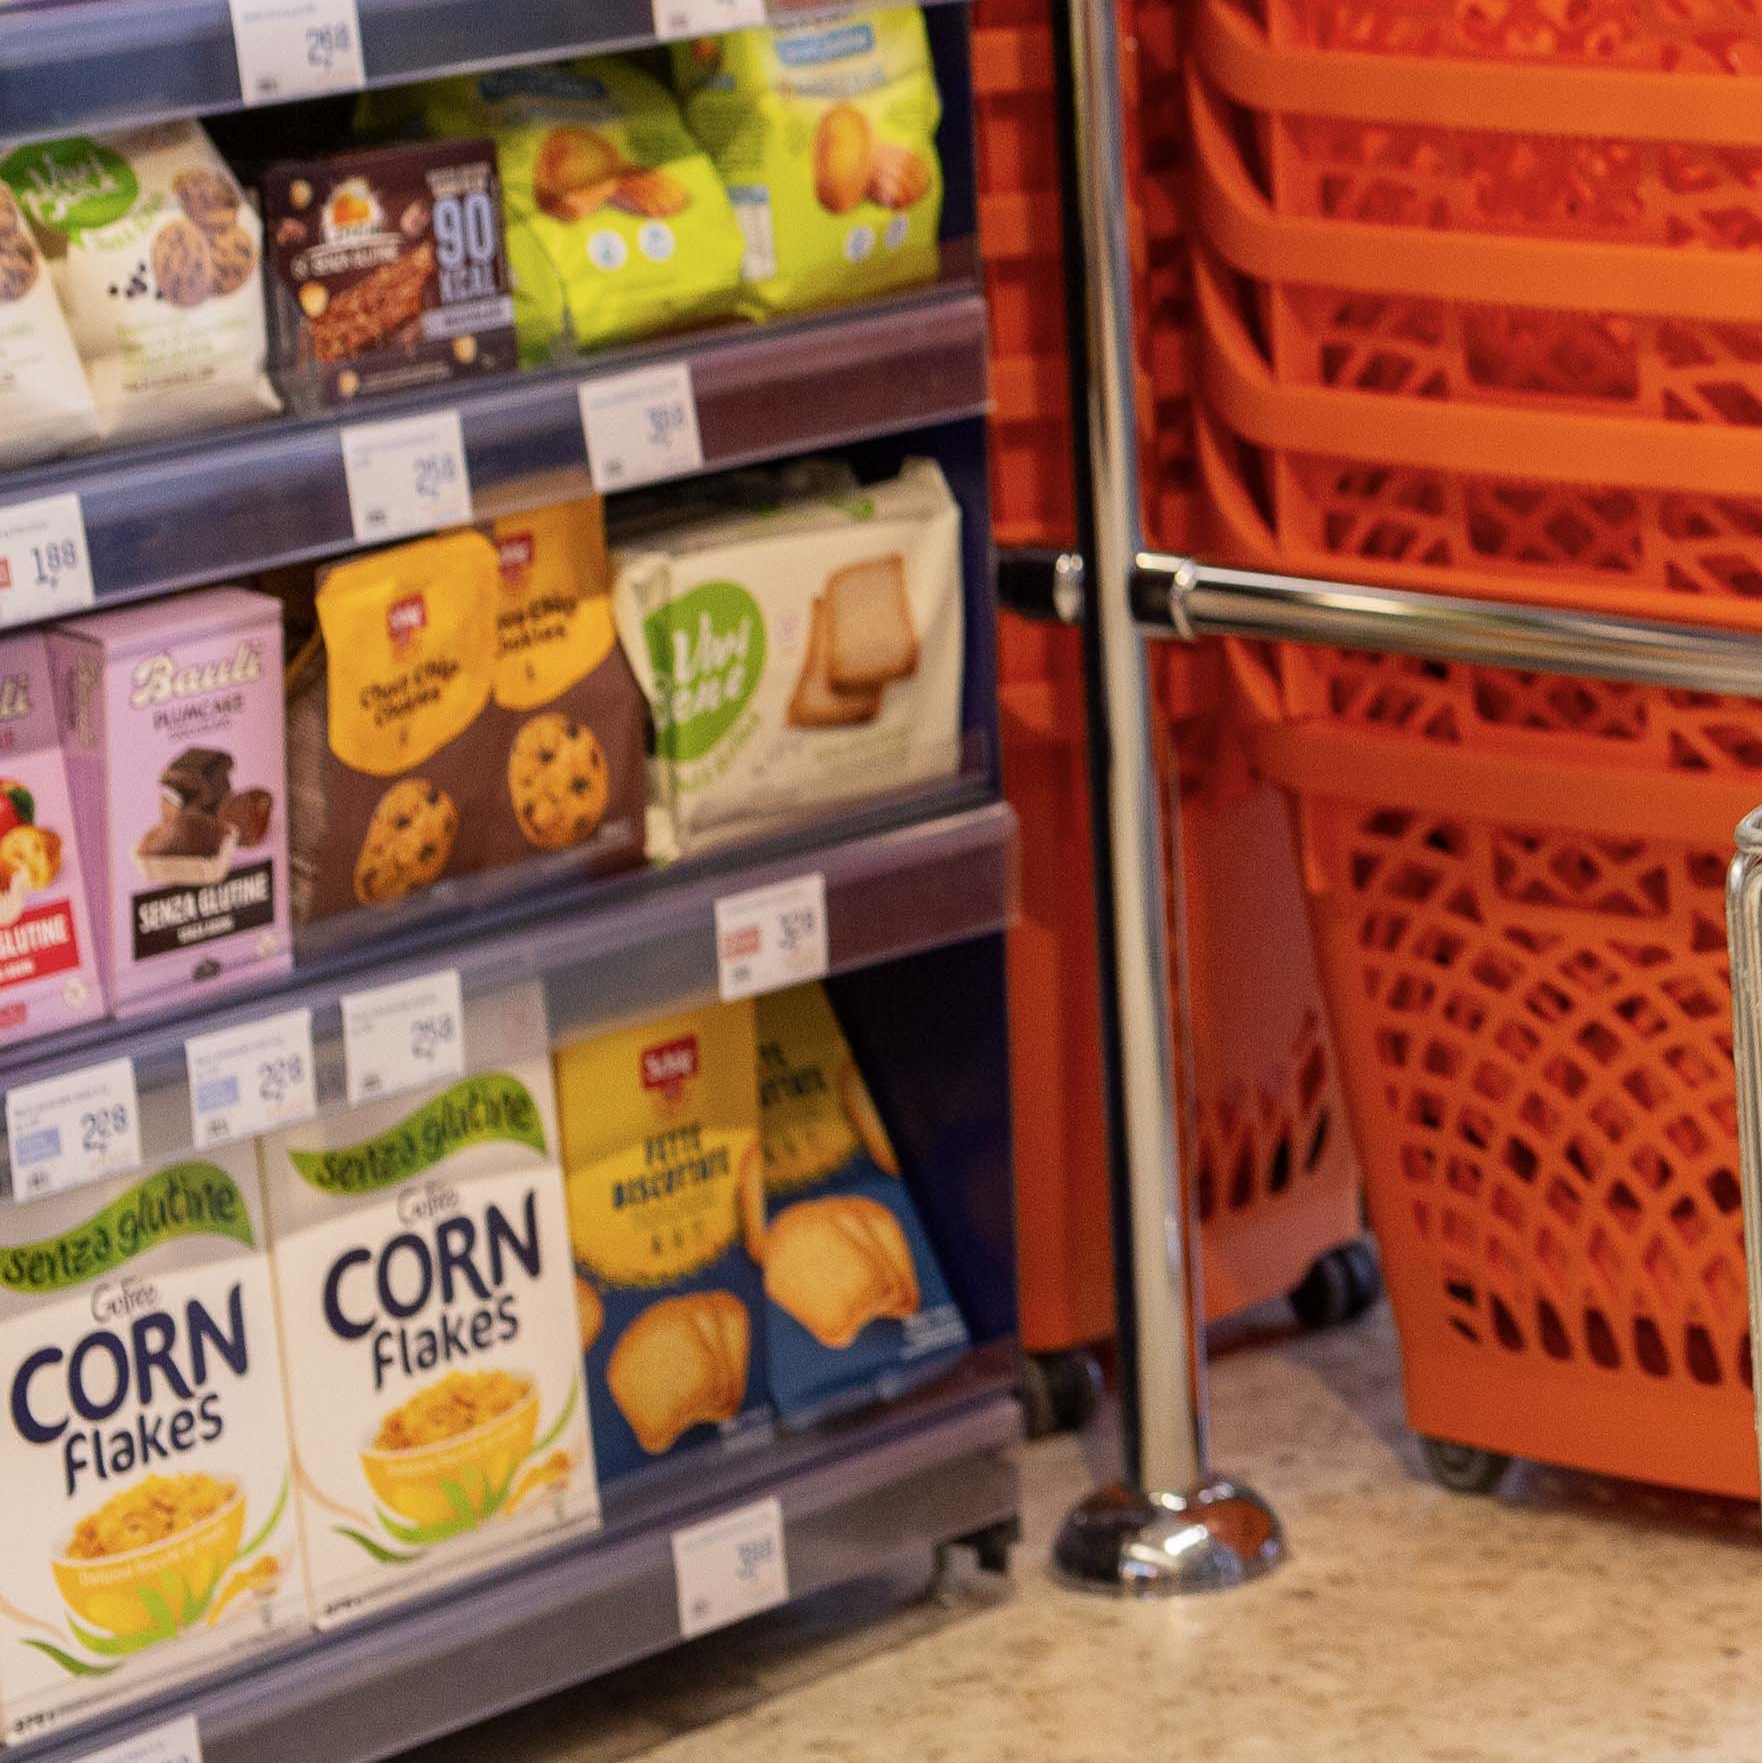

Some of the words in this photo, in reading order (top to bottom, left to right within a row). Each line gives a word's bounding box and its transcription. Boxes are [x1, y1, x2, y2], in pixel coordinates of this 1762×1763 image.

[431, 190, 497, 274] 90
[128, 640, 266, 711] Bauli
[138, 889, 195, 935] SENZA
[197, 871, 271, 918] GLUTINE
[313, 1135, 414, 1191] senza
[416, 1083, 536, 1166] glutine
[3, 1226, 113, 1288] senza
[116, 1168, 240, 1258] glutine
[322, 1185, 543, 1342] CORN
[10, 1280, 250, 1445] CORN
[371, 1293, 521, 1391] flakes
[64, 1392, 226, 1498] flakes
